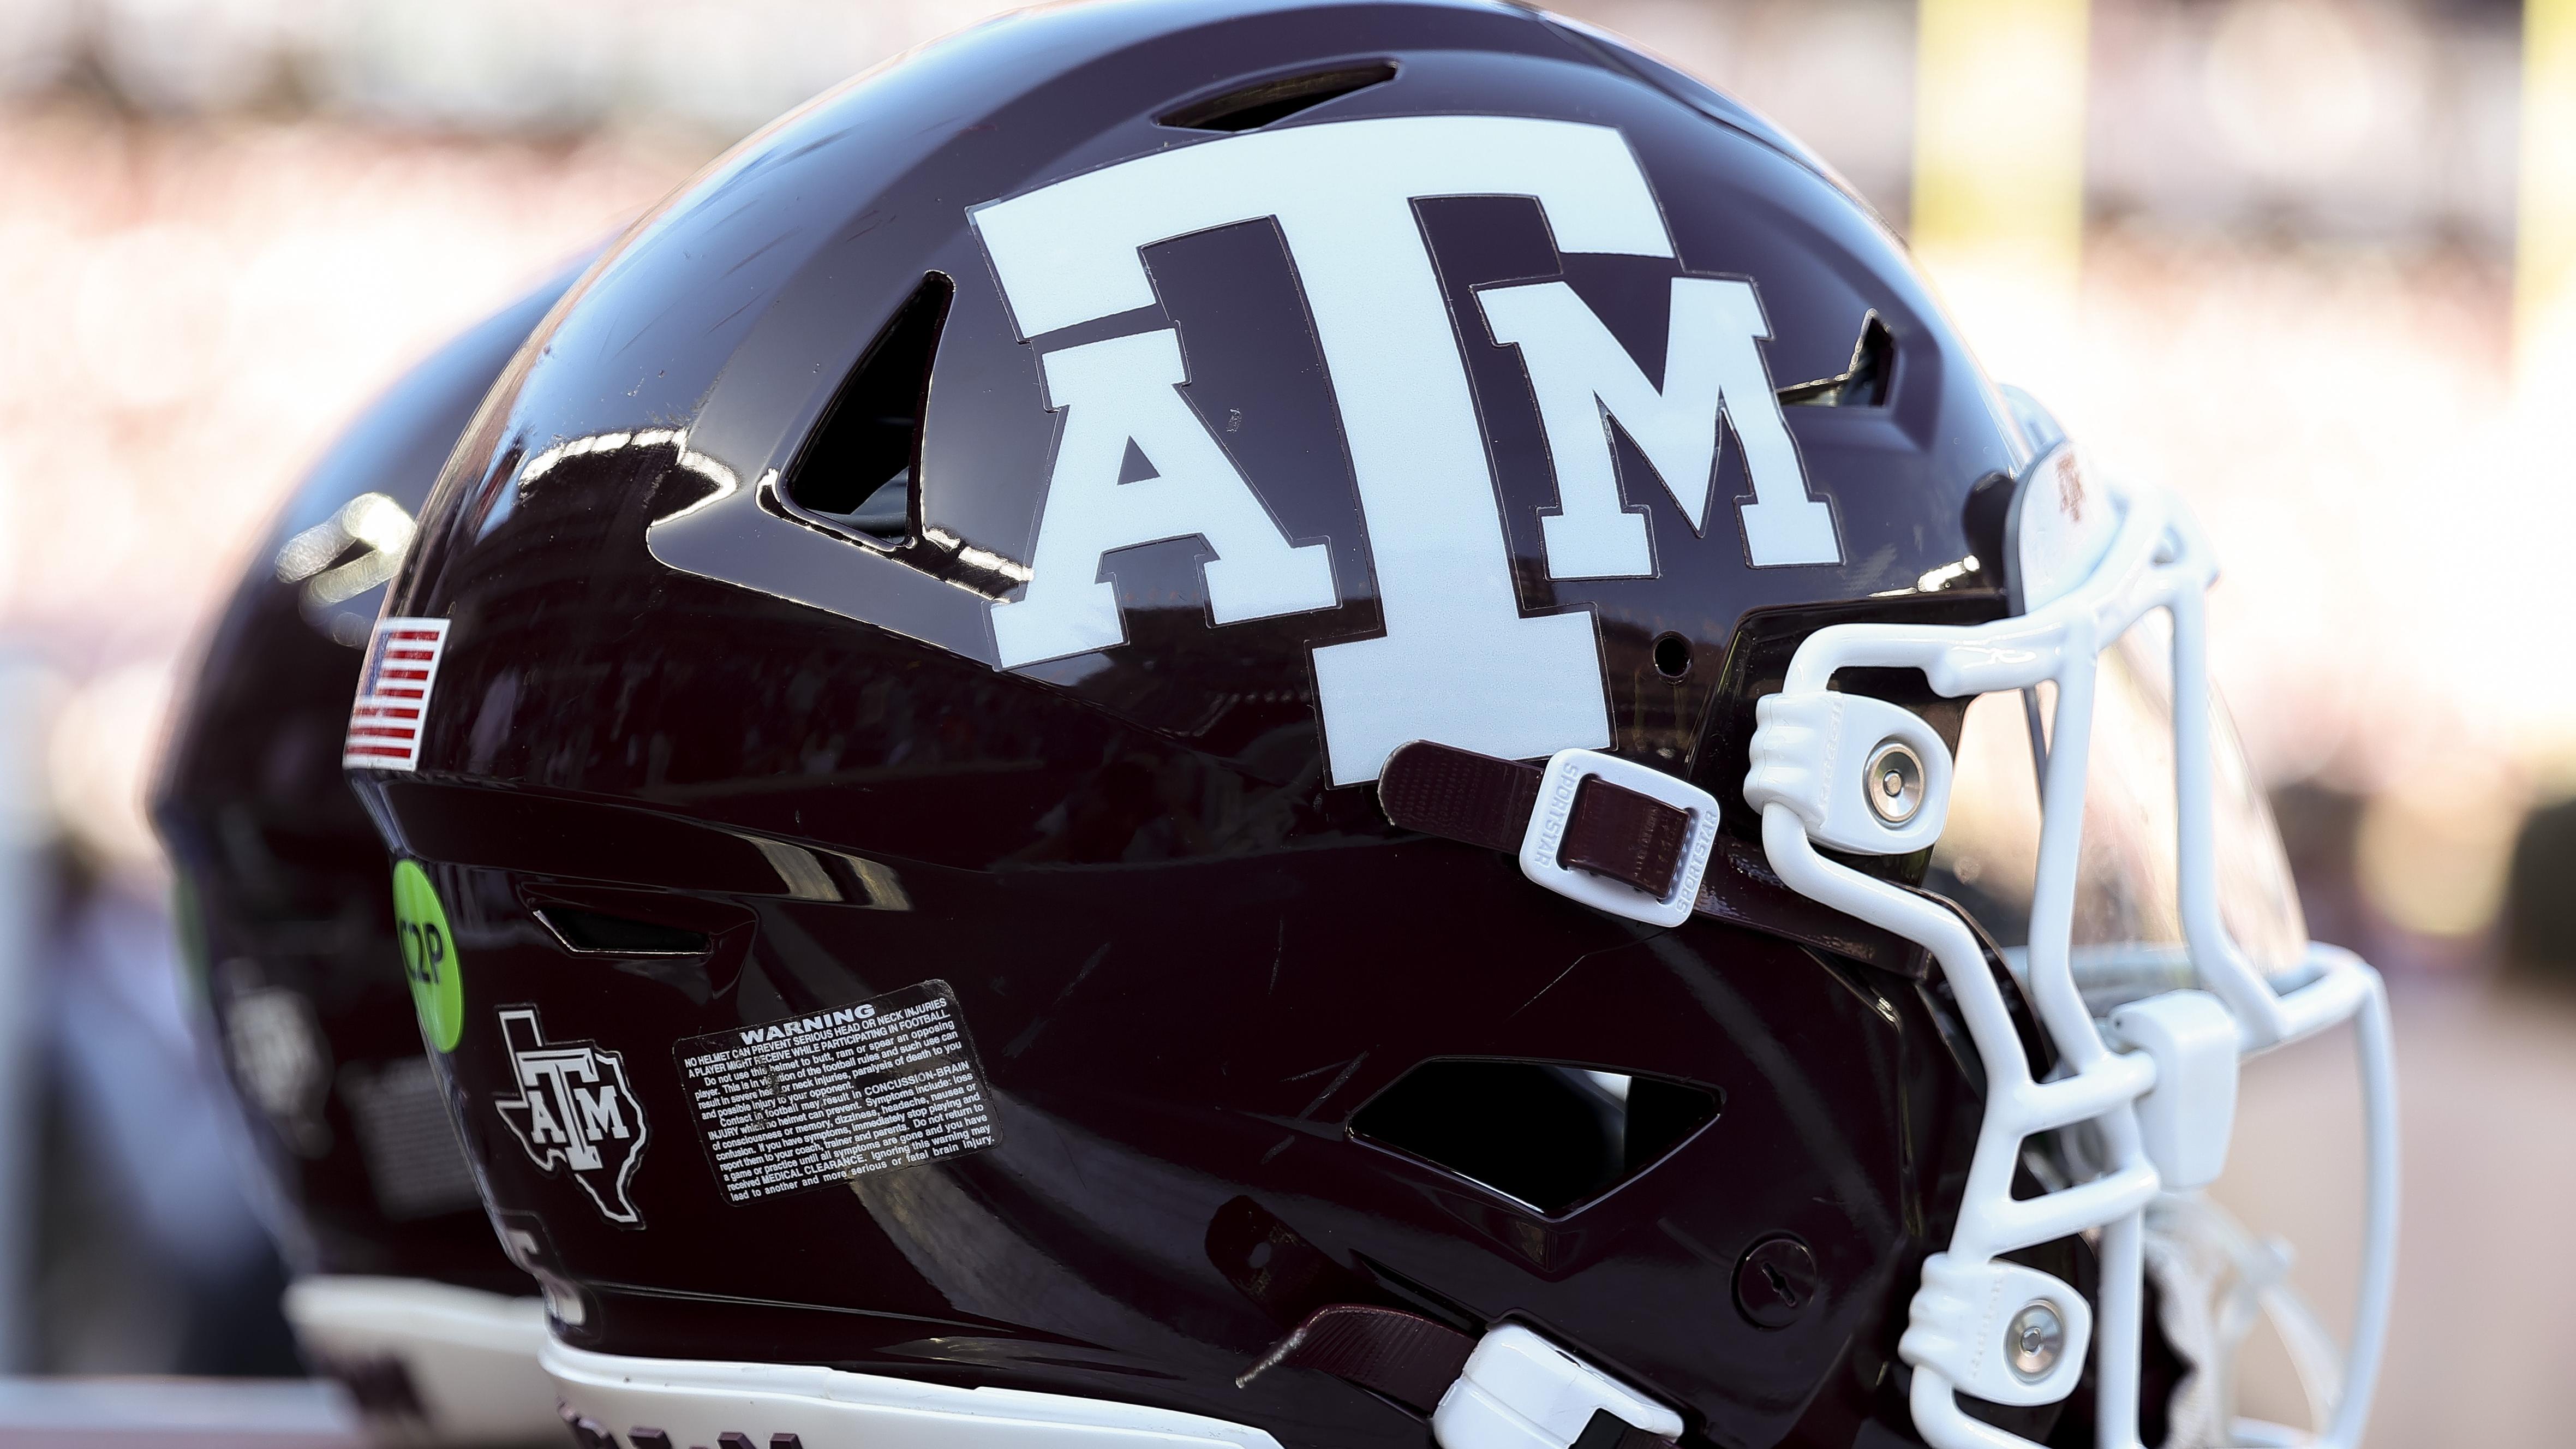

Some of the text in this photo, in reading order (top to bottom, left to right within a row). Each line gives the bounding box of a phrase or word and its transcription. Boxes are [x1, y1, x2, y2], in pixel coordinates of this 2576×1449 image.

[1534, 762, 1579, 867] SPORTSTAR
[1676, 810, 1718, 915] SPORTSTAR
[684, 998, 947, 1068] NO HELMET CAN PREVENT SERIOUS HEAD OR NECK INJURIES
[689, 1010, 951, 1078] A PLAYER MIGHT RECEIVE WHILE PARTICIPATING IN FOOTBALL.
[704, 1077, 716, 1086] Do
[718, 1074, 732, 1083] not
[733, 1072, 749, 1080] use
[751, 1066, 767, 1076] this
[769, 1060, 799, 1072] helmet
[812, 1053, 834, 1064] butt,
[836, 1049, 854, 1058] ram
[869, 1038, 896, 1051] spear
[897, 1034, 909, 1042] an
[911, 1021, 954, 1041] opposing
[739, 1004, 875, 1045] WARNING
[695, 1088, 721, 1101] player.
[722, 1083, 740, 1093] This
[750, 1080, 760, 1088] in
[760, 1073, 796, 1086] viotion
[797, 1069, 806, 1077] of
[807, 1067, 821, 1076] the
[822, 1057, 856, 1072] football
[857, 1050, 880, 1064] rules
[881, 1046, 898, 1058] and
[900, 1041, 922, 1053] such
[923, 1037, 940, 1046] use
[942, 1031, 958, 1041] can
[698, 1098, 721, 1110] result
[721, 1096, 730, 1105] in
[781, 1084, 790, 1093] or
[792, 1078, 814, 1090] neck
[814, 1072, 851, 1086] injuries,
[852, 1060, 894, 1078] paralysis
[895, 1056, 904, 1066] of
[906, 1050, 931, 1063] death
[943, 1042, 961, 1054] you
[720, 1061, 969, 1126] Contact in football may result in CONCUSSION-BRAIN
[702, 1081, 854, 1120] and possible injury to your opponent.
[708, 1126, 738, 1140] INJURY
[778, 1113, 807, 1126] helmet
[809, 1111, 824, 1119] can
[826, 1101, 862, 1118] prevent.
[865, 1089, 916, 1107] Symptoms
[915, 1079, 952, 1094] include:
[953, 1074, 973, 1084] loss
[713, 1141, 721, 1150] of
[722, 1131, 782, 1148] consciousness
[795, 1120, 833, 1133] memory,
[835, 1106, 881, 1124] dizziness,
[881, 1097, 929, 1113] headache,
[930, 1087, 965, 1101] nausea
[716, 1092, 980, 1160] confusion. If you have symptoms, immediately stop playing and
[720, 1159, 744, 1171] report
[744, 1156, 764, 1166] them
[774, 1149, 793, 1161] your
[795, 1143, 823, 1155] coach,
[824, 1137, 852, 1148] trainer
[854, 1131, 871, 1141] and
[873, 1124, 910, 1139] parents.
[913, 1119, 927, 1128] Do
[928, 1113, 944, 1124] not
[945, 1107, 972, 1119] return
[727, 1125, 990, 1191] received MEDICAL CLEARANCE. Ignoring this warning may
[730, 1190, 749, 1201] lead
[764, 1182, 797, 1194] another
[802, 1175, 819, 1186] and
[823, 1171, 847, 1182] more
[851, 1160, 887, 1175] serious
[906, 1150, 929, 1162] fatal
[933, 1144, 959, 1156] brain
[963, 1136, 994, 1148] injury.
[731, 1170, 752, 1181] game
[764, 1160, 798, 1174] practice
[799, 1153, 818, 1165] until
[821, 1150, 832, 1160] all
[834, 1141, 880, 1160] symptoms
[883, 1137, 897, 1146] are
[900, 1131, 923, 1143] gone
[925, 1124, 943, 1136] and
[945, 1121, 963, 1132] you
[964, 1115, 987, 1126] have
